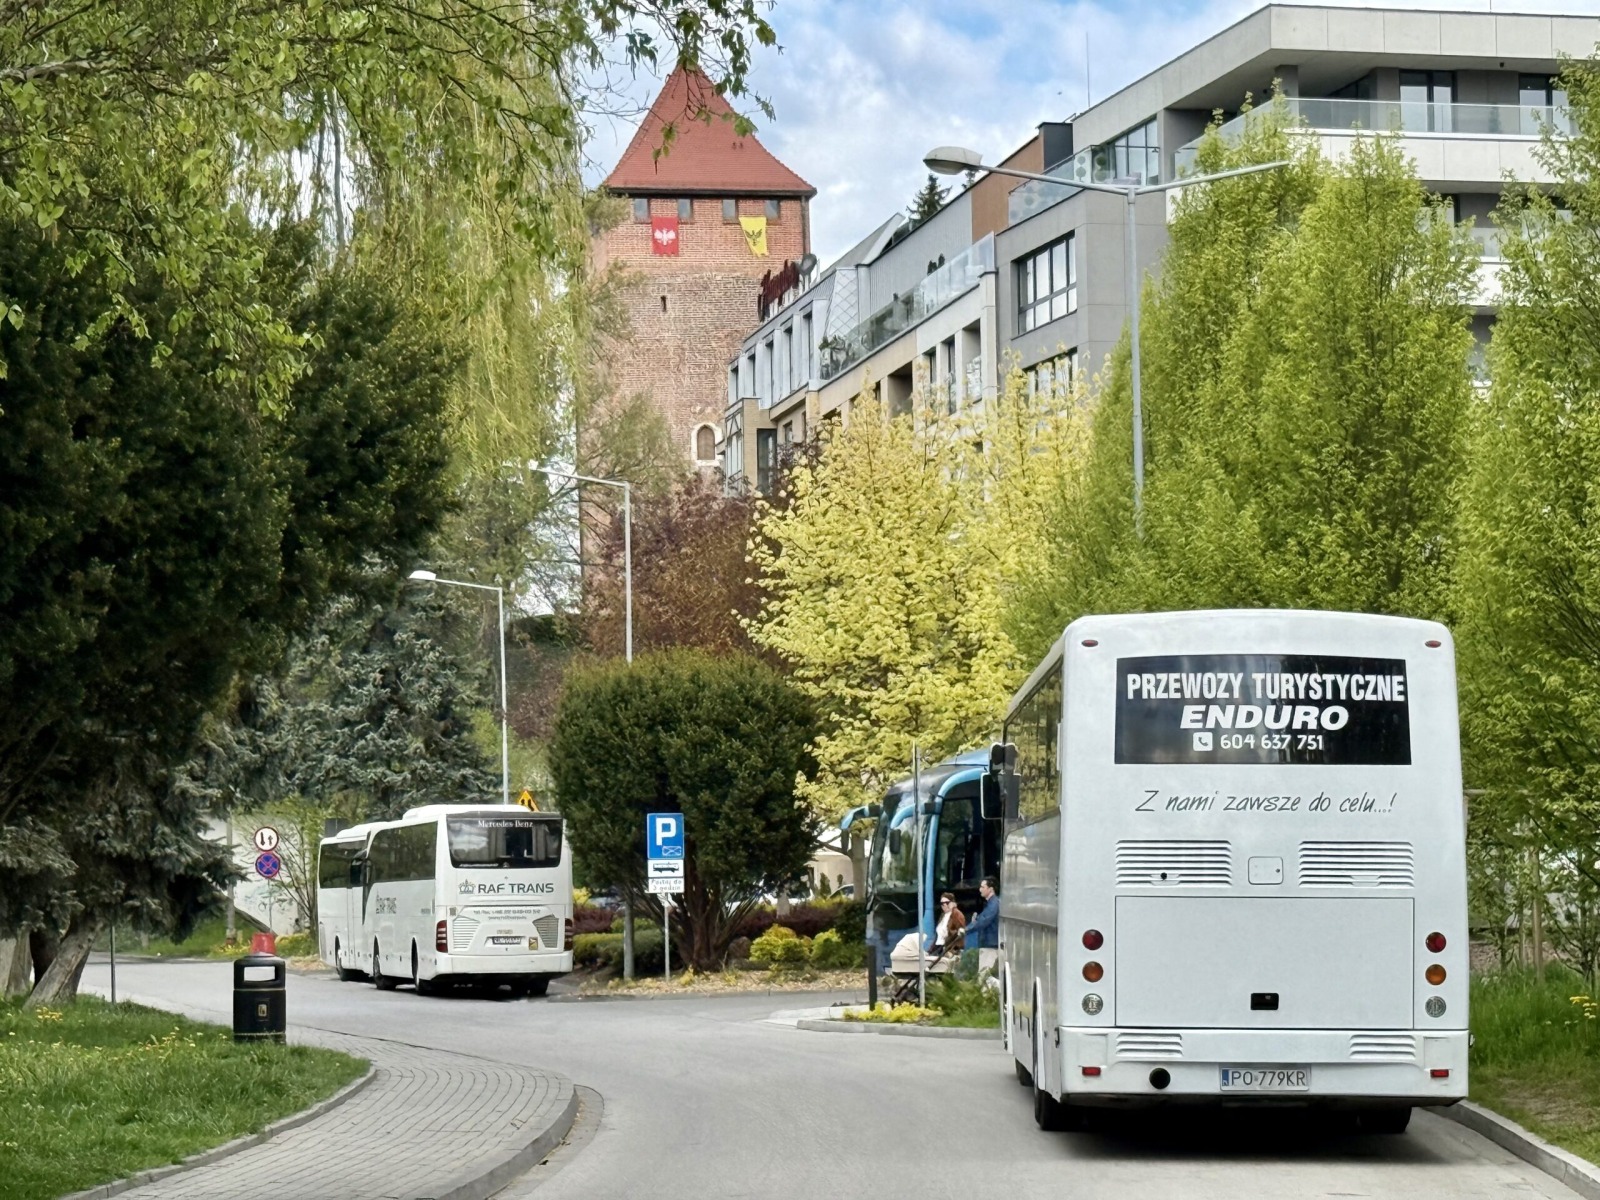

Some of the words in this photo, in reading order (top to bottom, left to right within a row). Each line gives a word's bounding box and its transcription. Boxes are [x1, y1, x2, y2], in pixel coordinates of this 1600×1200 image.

[1126, 672, 1244, 700] PRZEWOZY
[1251, 672, 1406, 702] TURYSTYCZNE
[1180, 704, 1349, 731] ENDURO
[1220, 733, 1256, 750] 604
[1261, 733, 1291, 750] 637
[1297, 733, 1324, 750] 751
[1135, 789, 1159, 812] Z
[1165, 789, 1220, 812] nami
[1223, 794, 1302, 813] zawsze
[1308, 791, 1331, 813] do
[656, 817, 677, 846] P
[477, 883, 506, 894] RAF
[508, 882, 555, 894] TRANS
[1230, 1070, 1253, 1086] PO
[1257, 1070, 1306, 1087] 779KR
